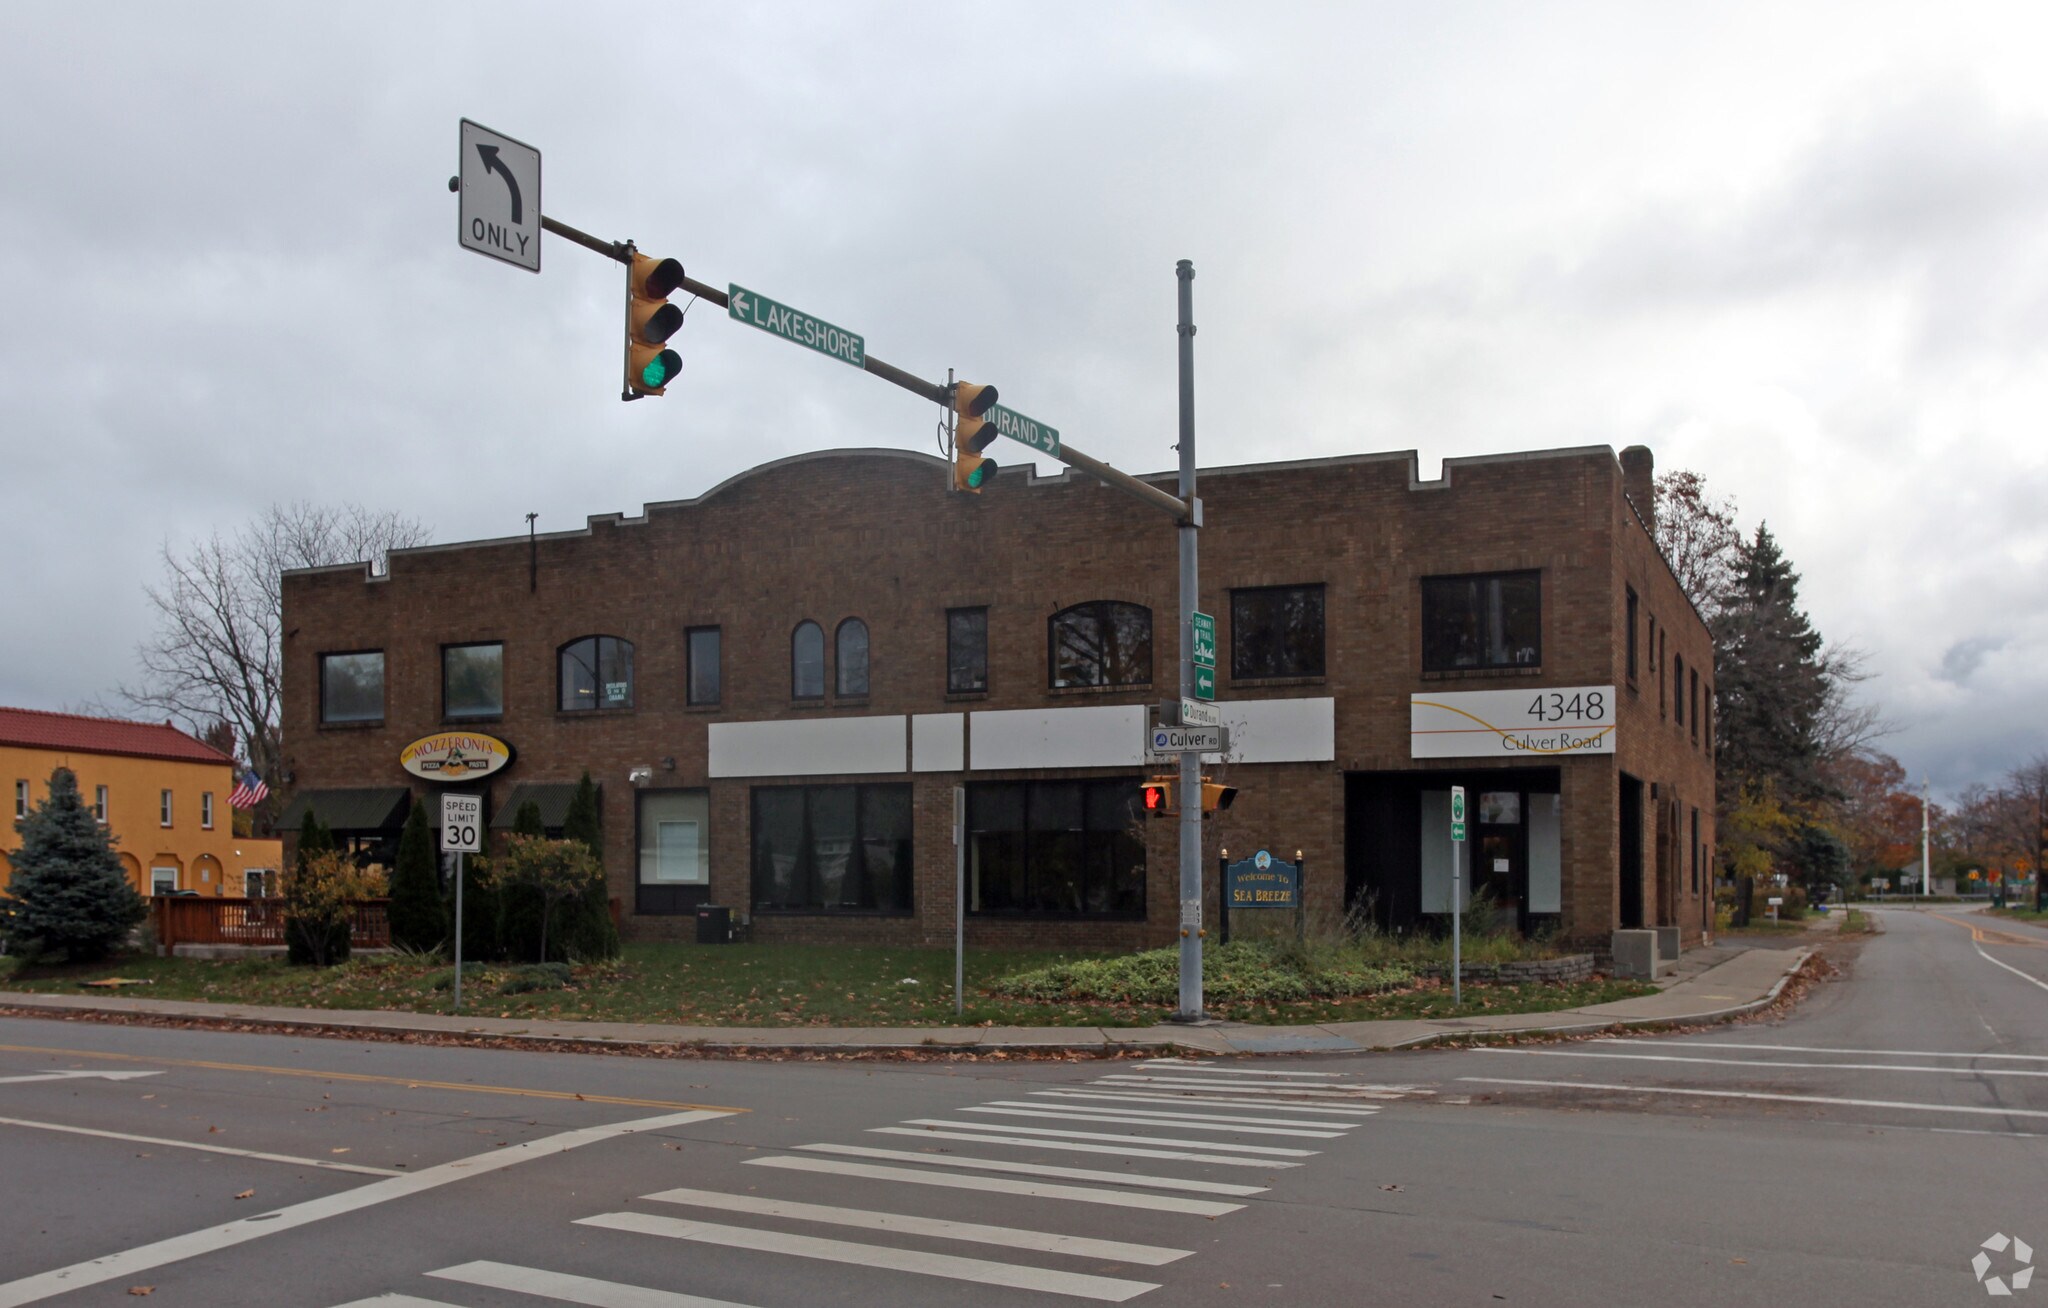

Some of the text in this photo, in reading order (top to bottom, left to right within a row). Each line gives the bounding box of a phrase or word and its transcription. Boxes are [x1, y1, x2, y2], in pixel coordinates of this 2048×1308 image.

[472, 218, 529, 256] ONLY
[754, 298, 860, 363] LAKESHORE
[1195, 616, 1212, 629] SEAWAY
[1200, 629, 1212, 642] TRAIL
[1190, 705, 1208, 722] Durand
[1528, 692, 1604, 722] 4348
[1170, 732, 1217, 747] Culver RD
[1502, 732, 1602, 751] Culver Road
[414, 736, 494, 759] MOZZERONI'S
[468, 761, 487, 769] PASTA
[446, 801, 477, 812] SPEED
[448, 814, 475, 822] LIMIT
[447, 825, 475, 845] 30
[1237, 873, 1289, 884] Welcome To
[1233, 889, 1292, 902] SEA BREEZE
